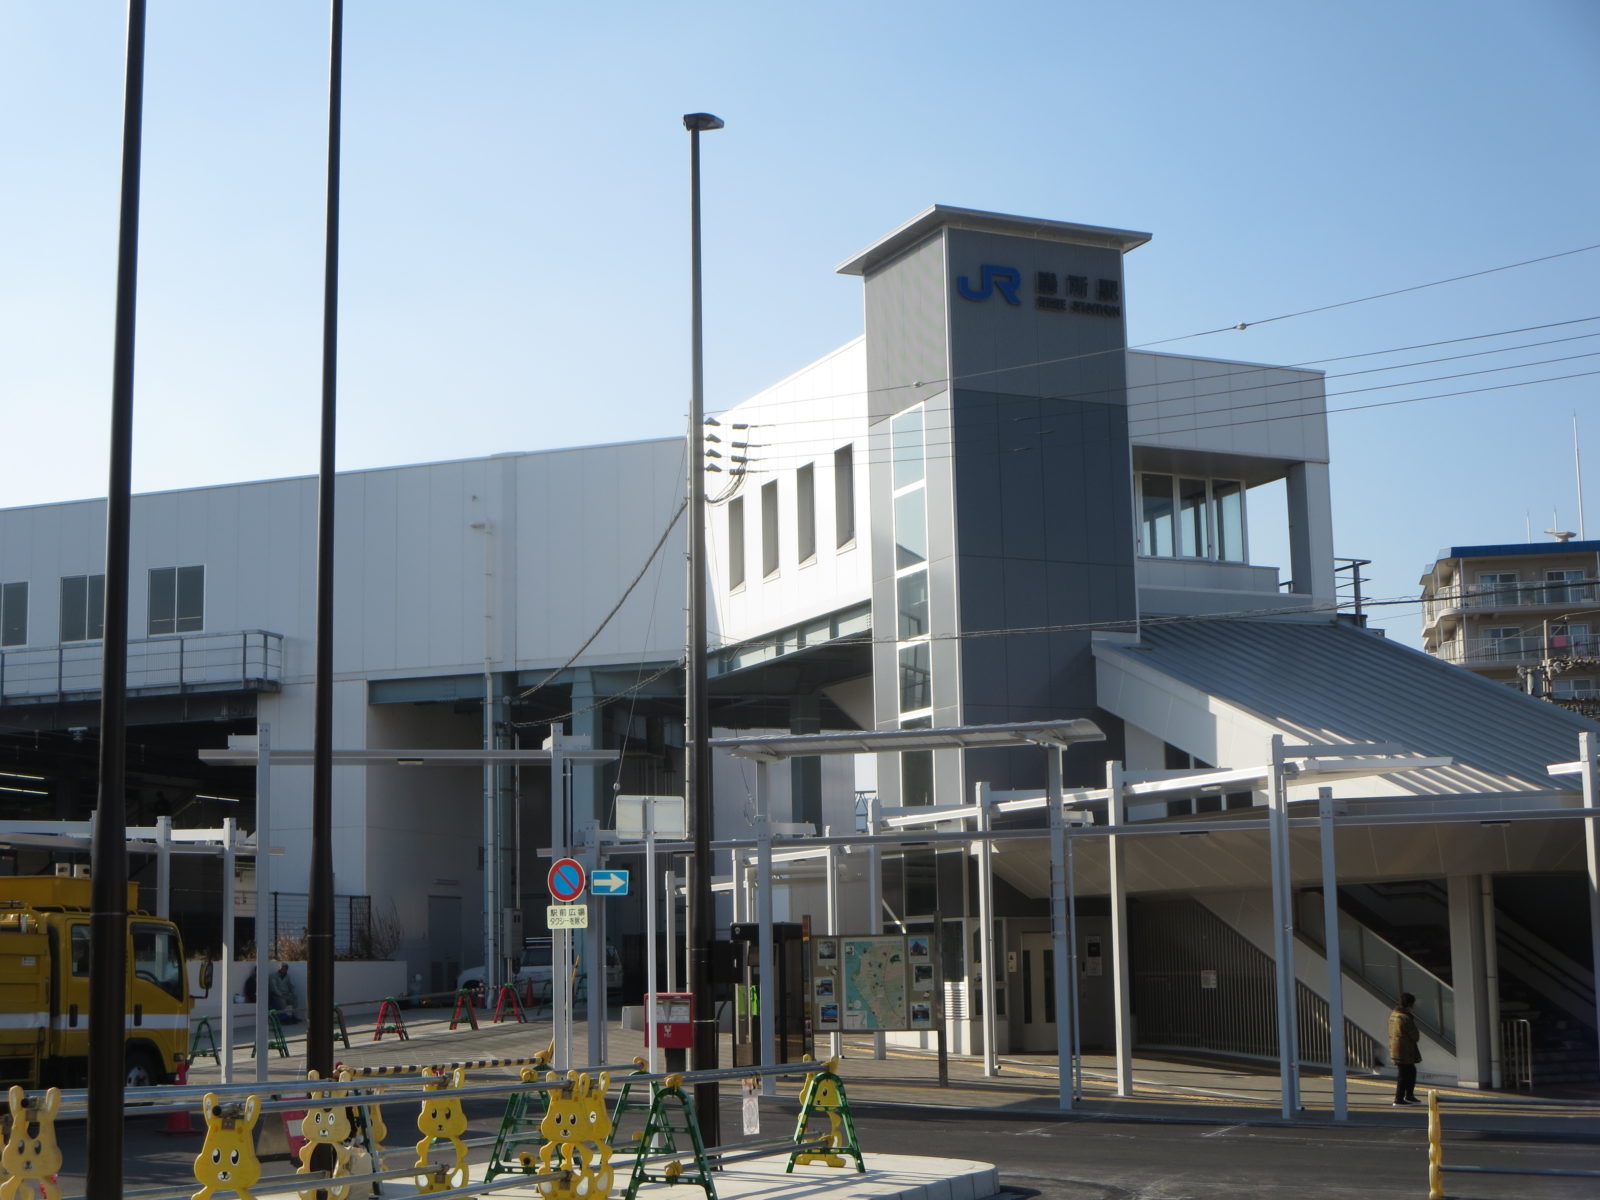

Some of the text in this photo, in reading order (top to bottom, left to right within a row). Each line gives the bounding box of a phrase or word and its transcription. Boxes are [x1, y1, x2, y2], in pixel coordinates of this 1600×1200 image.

[957, 264, 1022, 306] JR
[550, 908, 586, 917] 駅前広場
[550, 917, 586, 926] タクシーを除く
